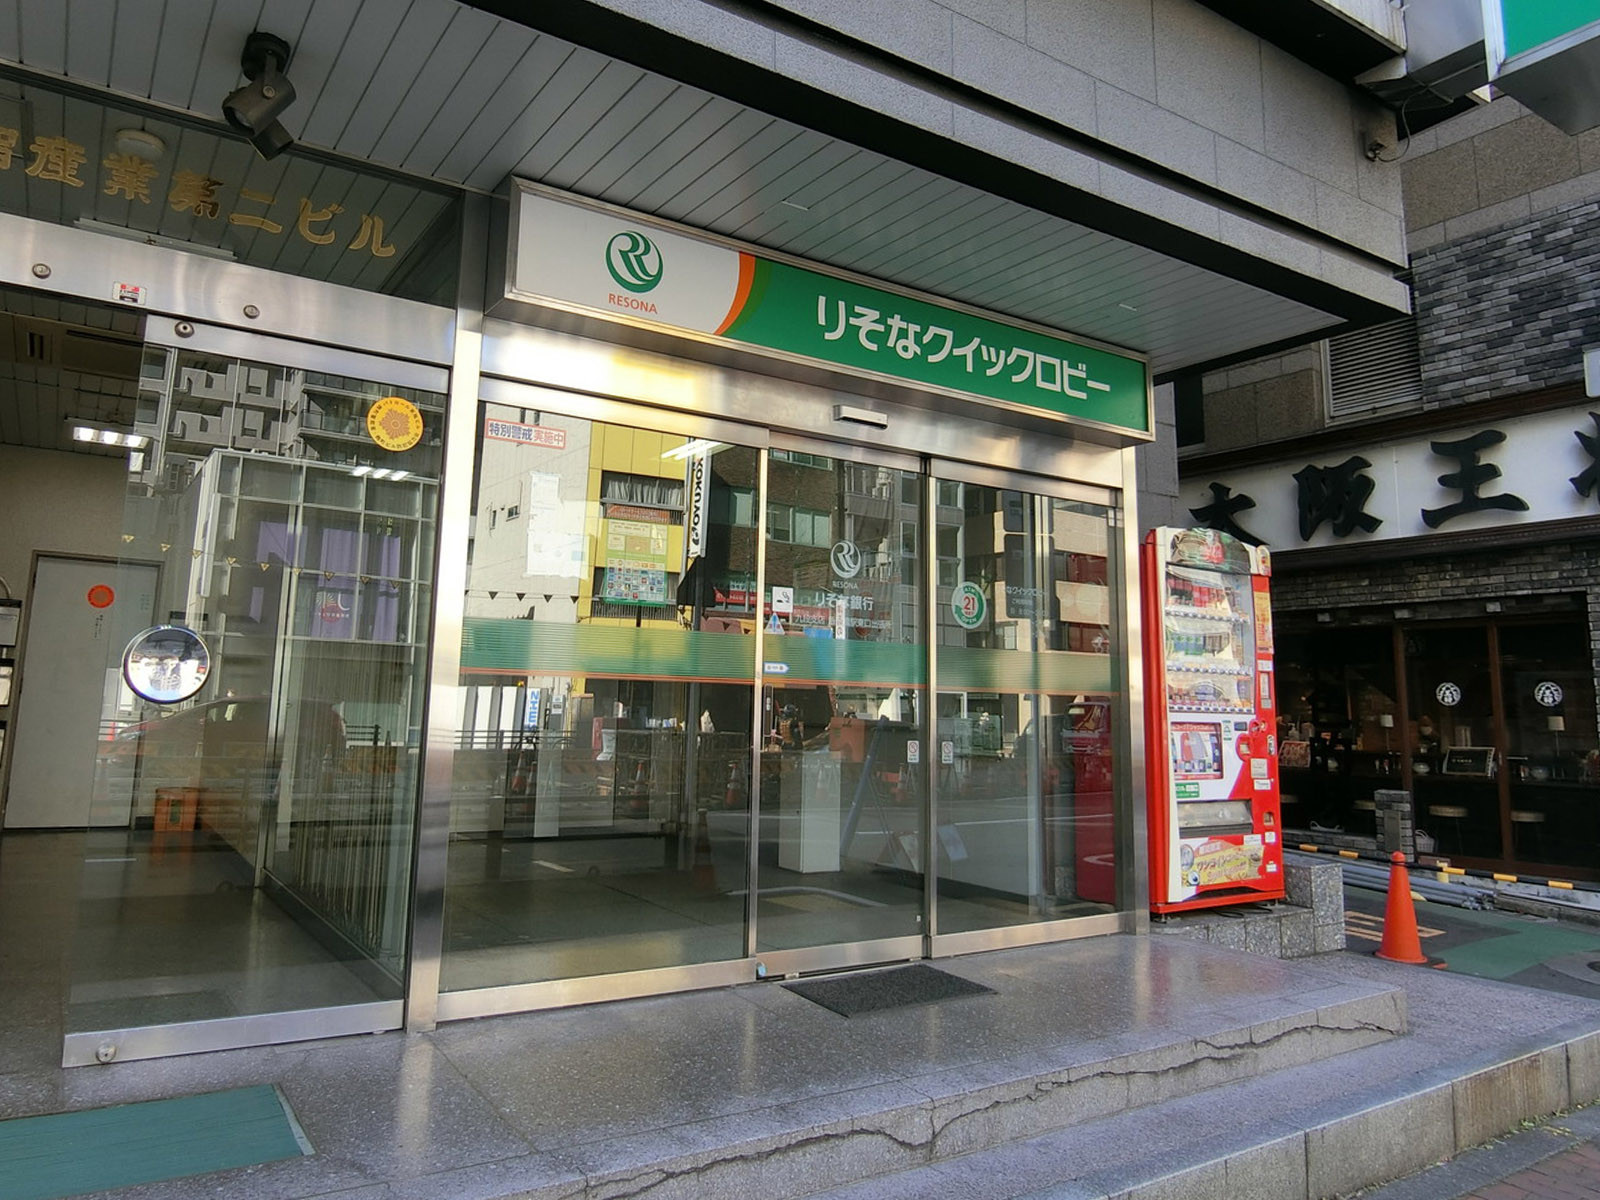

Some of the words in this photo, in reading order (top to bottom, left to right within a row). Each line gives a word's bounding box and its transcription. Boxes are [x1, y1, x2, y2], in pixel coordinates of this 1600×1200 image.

[608, 292, 658, 315] RESONA
[817, 295, 1111, 400] りそなクイックロビー
[832, 580, 858, 590] RESONA
[815, 591, 874, 611] りそな銀行
[963, 595, 976, 611] 21
